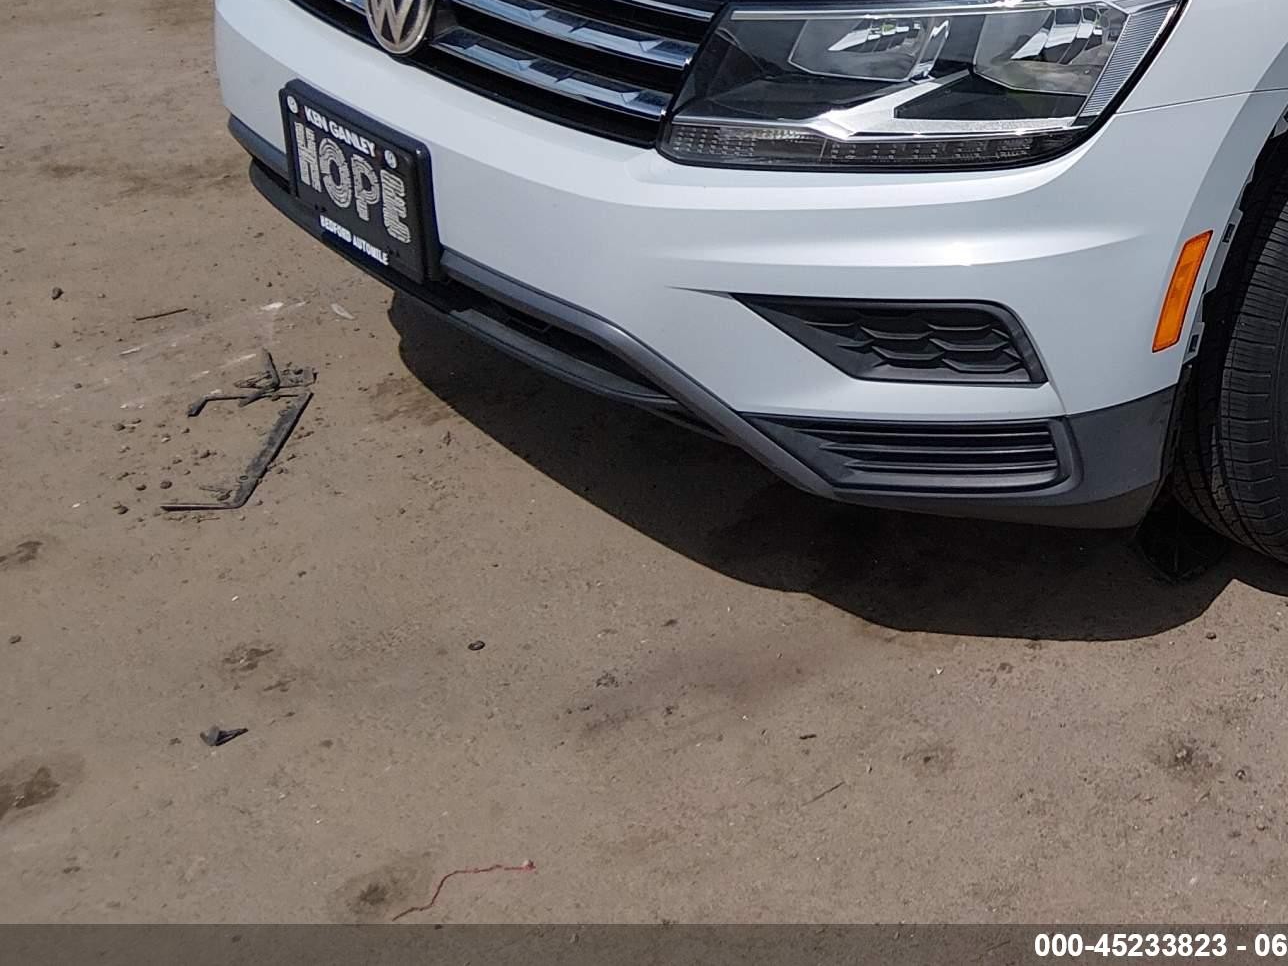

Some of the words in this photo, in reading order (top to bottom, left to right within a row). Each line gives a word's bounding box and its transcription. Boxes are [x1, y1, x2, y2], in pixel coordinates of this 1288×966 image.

[304, 105, 329, 133] KEN
[328, 120, 376, 157] GANLEY
[294, 122, 411, 244] HOPE
